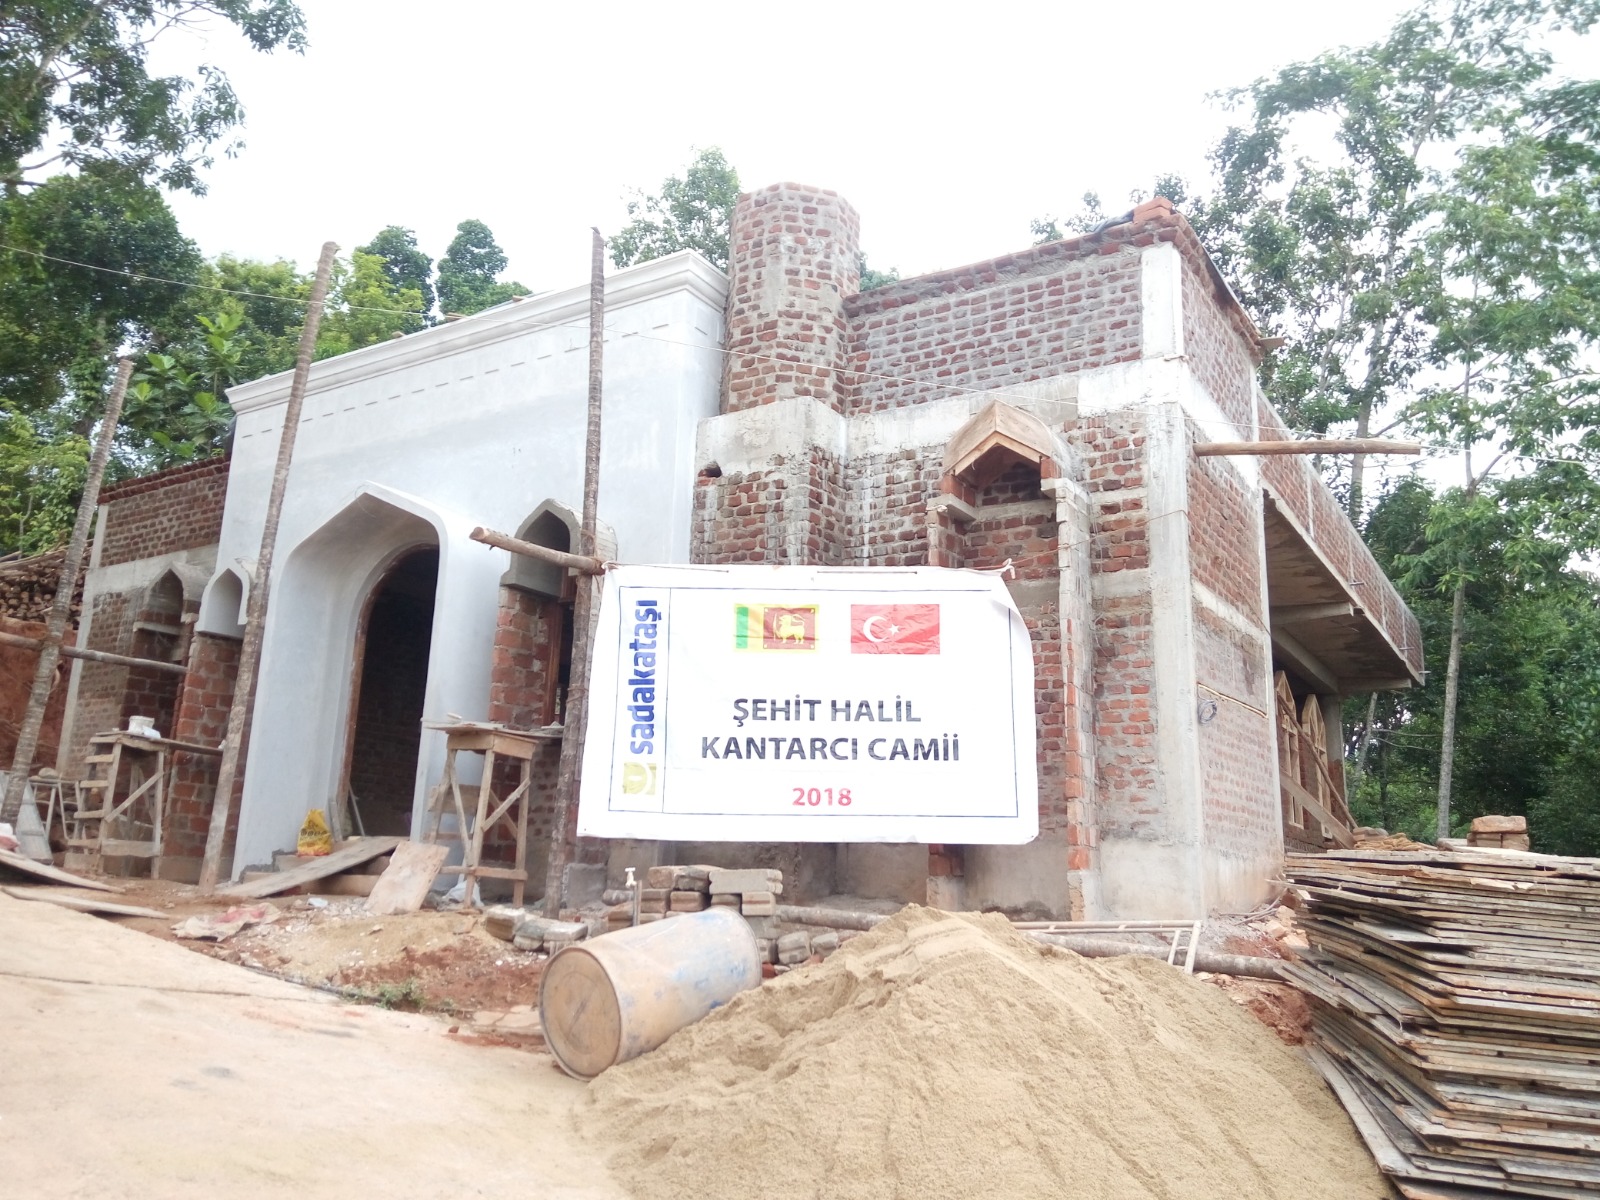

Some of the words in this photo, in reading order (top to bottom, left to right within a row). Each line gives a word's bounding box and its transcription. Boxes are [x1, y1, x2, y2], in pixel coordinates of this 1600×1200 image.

[627, 600, 662, 755] sadakataşı
[732, 694, 821, 728] ŞEHİT
[831, 695, 922, 723] HALİL
[701, 736, 859, 761] KANTARCI
[868, 734, 960, 762] CAMİİ
[792, 787, 852, 807] 2018
